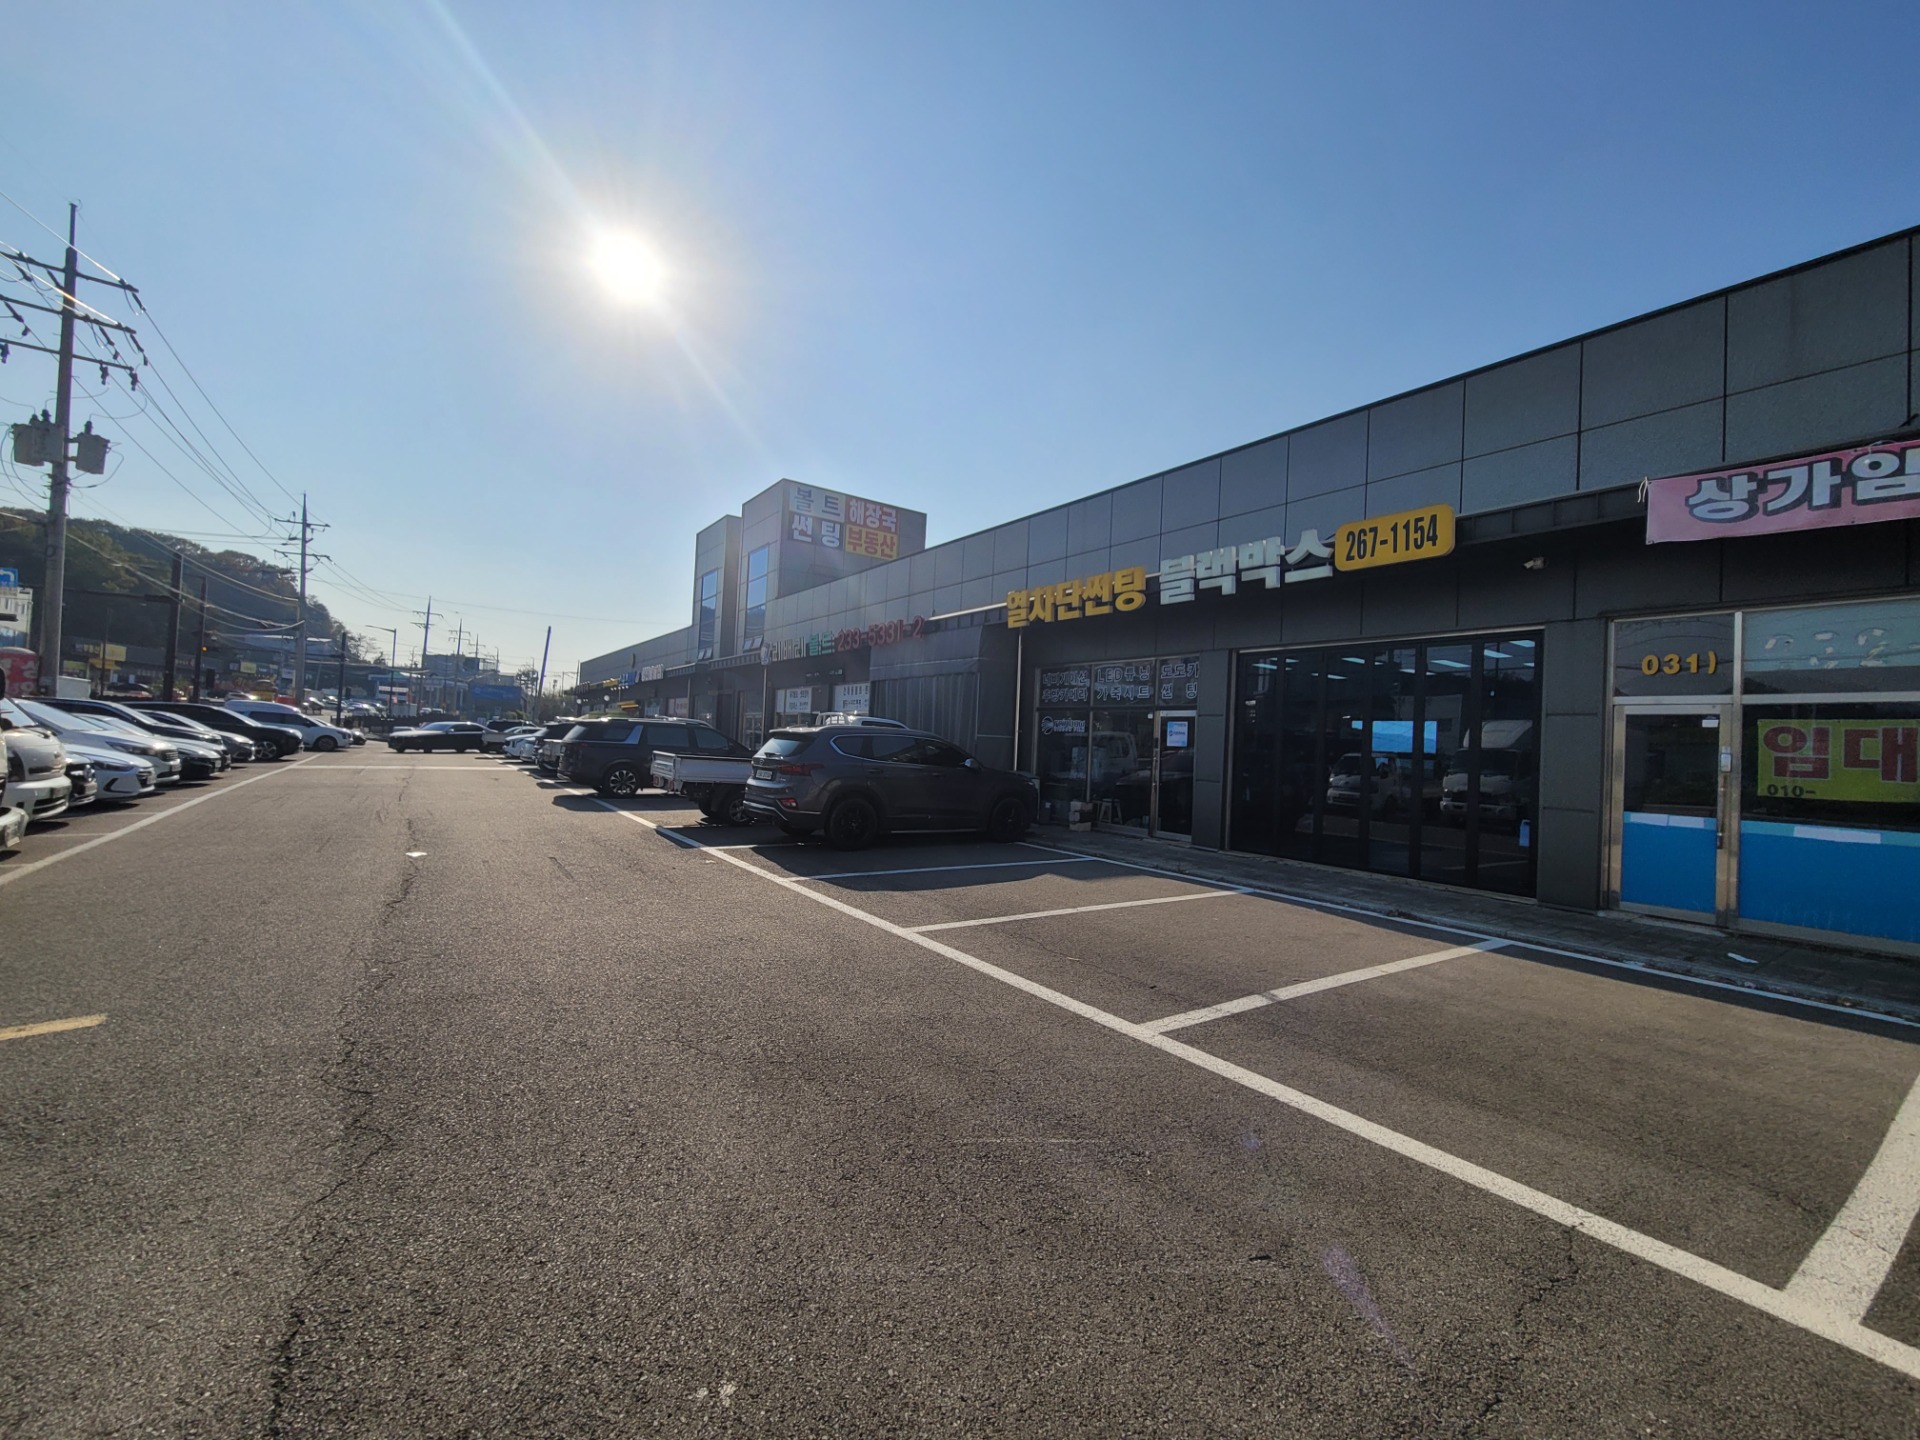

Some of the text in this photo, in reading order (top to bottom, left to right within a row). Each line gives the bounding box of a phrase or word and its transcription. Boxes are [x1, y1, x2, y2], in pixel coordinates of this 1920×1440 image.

[794, 487, 841, 517] 볼트
[849, 498, 897, 533] 해장국
[791, 514, 841, 548] 썬팅
[847, 526, 896, 559] 부동산
[1345, 514, 1438, 561] 267-1154
[1007, 528, 1334, 629] 열차단썬팅 블랙박스
[1641, 651, 1718, 675] 031)
[1096, 684, 1151, 701] 가죽시트
[1762, 725, 1919, 783] 임대
[1766, 783, 1817, 798] 010-
